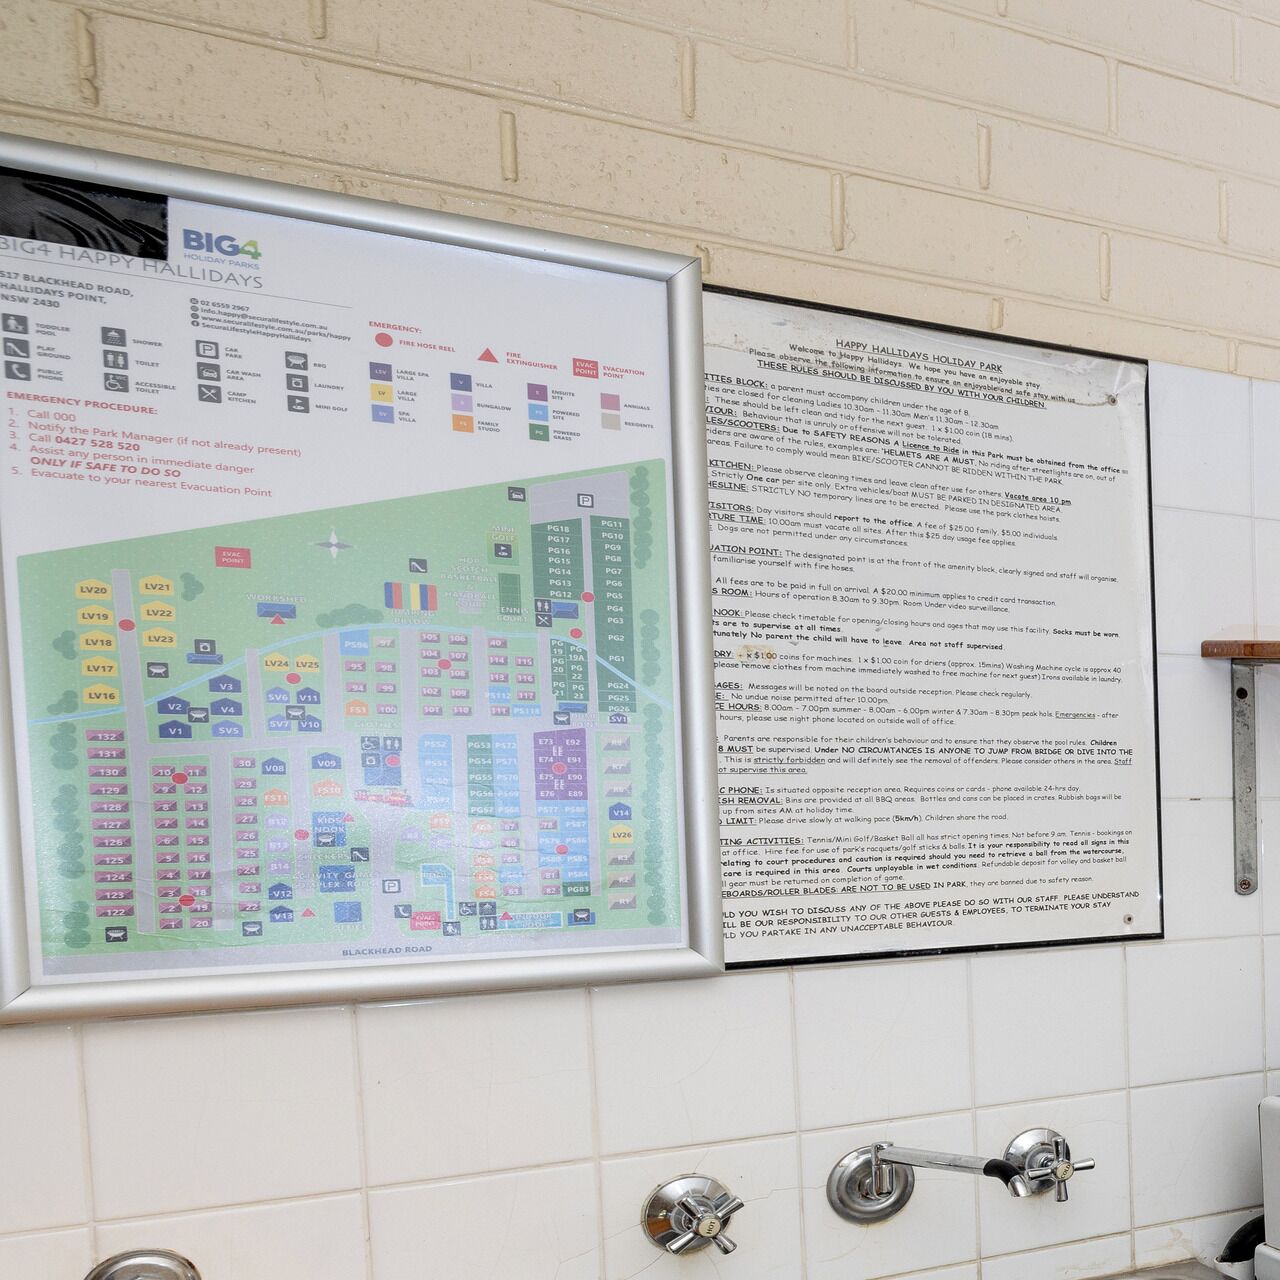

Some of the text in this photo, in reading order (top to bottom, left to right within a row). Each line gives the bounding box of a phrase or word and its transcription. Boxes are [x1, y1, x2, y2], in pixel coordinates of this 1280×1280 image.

[183, 228, 262, 260] BIG4
[60, 245, 134, 270] HAPPY
[143, 259, 264, 289] HALLIDAYS
[184, 253, 259, 270] HOLIDAY PARKS
[22, 274, 94, 289] BLACKHEAD
[0, 282, 64, 296] HALLIDAYS
[0, 293, 60, 307] NSW 2430
[368, 321, 422, 333] EMERGENCY:
[836, 339, 1002, 373] HAPPY HALLIDAYS HOLIDAY PARK
[757, 359, 787, 371] THESE
[790, 364, 818, 376] RULES
[822, 369, 857, 381] SHOULD
[860, 374, 870, 384] BE
[872, 377, 921, 390] DISCUSSED
[924, 383, 934, 393] BY
[937, 386, 954, 396] YOU
[957, 389, 980, 399] WITH
[981, 393, 1003, 403] YOUR
[6, 391, 157, 414] EMERGENCY PROCEDURE:
[8, 408, 76, 422] 1. Call 000
[8, 418, 19, 428] 2.
[27, 421, 65, 434] Notify
[69, 426, 89, 435] the
[90, 427, 118, 437] Park
[121, 431, 173, 444] Manager
[176, 436, 188, 445] (if
[214, 441, 253, 452] already
[257, 446, 301, 456] present)
[9, 430, 140, 451] 3. Call 0427 528 520
[9, 443, 254, 474] 4. Assist any person in immediate danger
[30, 456, 180, 477] ONLY IF SAFE TO DO SO
[12, 466, 22, 475] 5.
[30, 468, 84, 480] Evacuate
[103, 476, 130, 484] your
[134, 479, 177, 488] nearest
[179, 481, 240, 493] Evacuation
[244, 487, 272, 496] Point
[80, 586, 107, 595] LV20
[145, 583, 170, 591] LV21
[82, 612, 109, 621] LV19
[147, 609, 173, 617] LV22
[85, 638, 112, 647] LV18
[148, 635, 174, 643] LV23
[87, 665, 114, 673] LV17
[88, 692, 116, 700] LV16
[807, 906, 846, 914] DISCUSS
[1063, 893, 1089, 901] PLEASE
[1091, 891, 1139, 900] UNDERSTAND
[342, 946, 402, 956] BLACKHEAD
[1061, 1164, 1070, 1179] COLD
[706, 1221, 715, 1234] HOT
